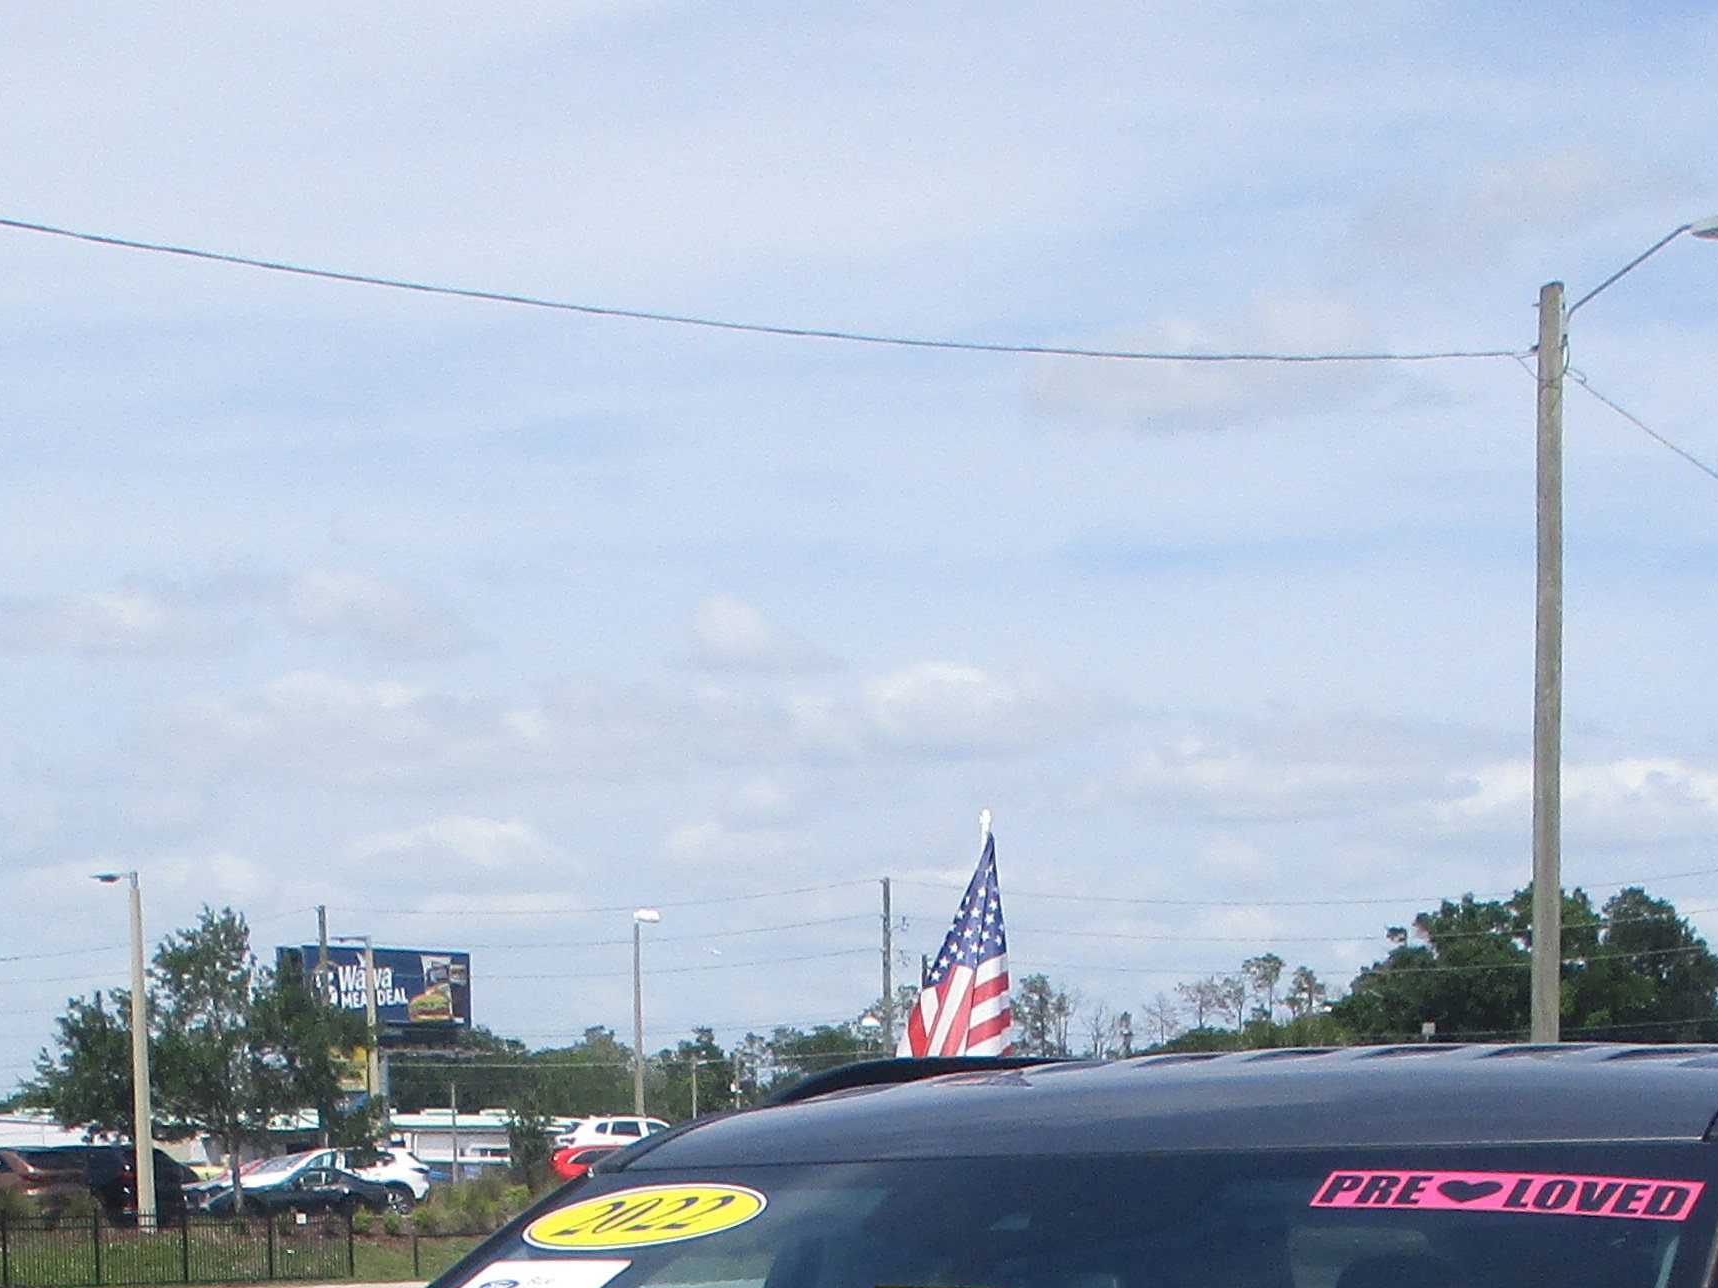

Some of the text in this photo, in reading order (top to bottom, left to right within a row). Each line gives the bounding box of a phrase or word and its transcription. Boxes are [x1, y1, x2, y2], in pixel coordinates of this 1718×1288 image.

[341, 987, 409, 1008] MEA DEAL
[549, 1194, 736, 1237] 2022
[1321, 1175, 1691, 1216] PRE LOVED
